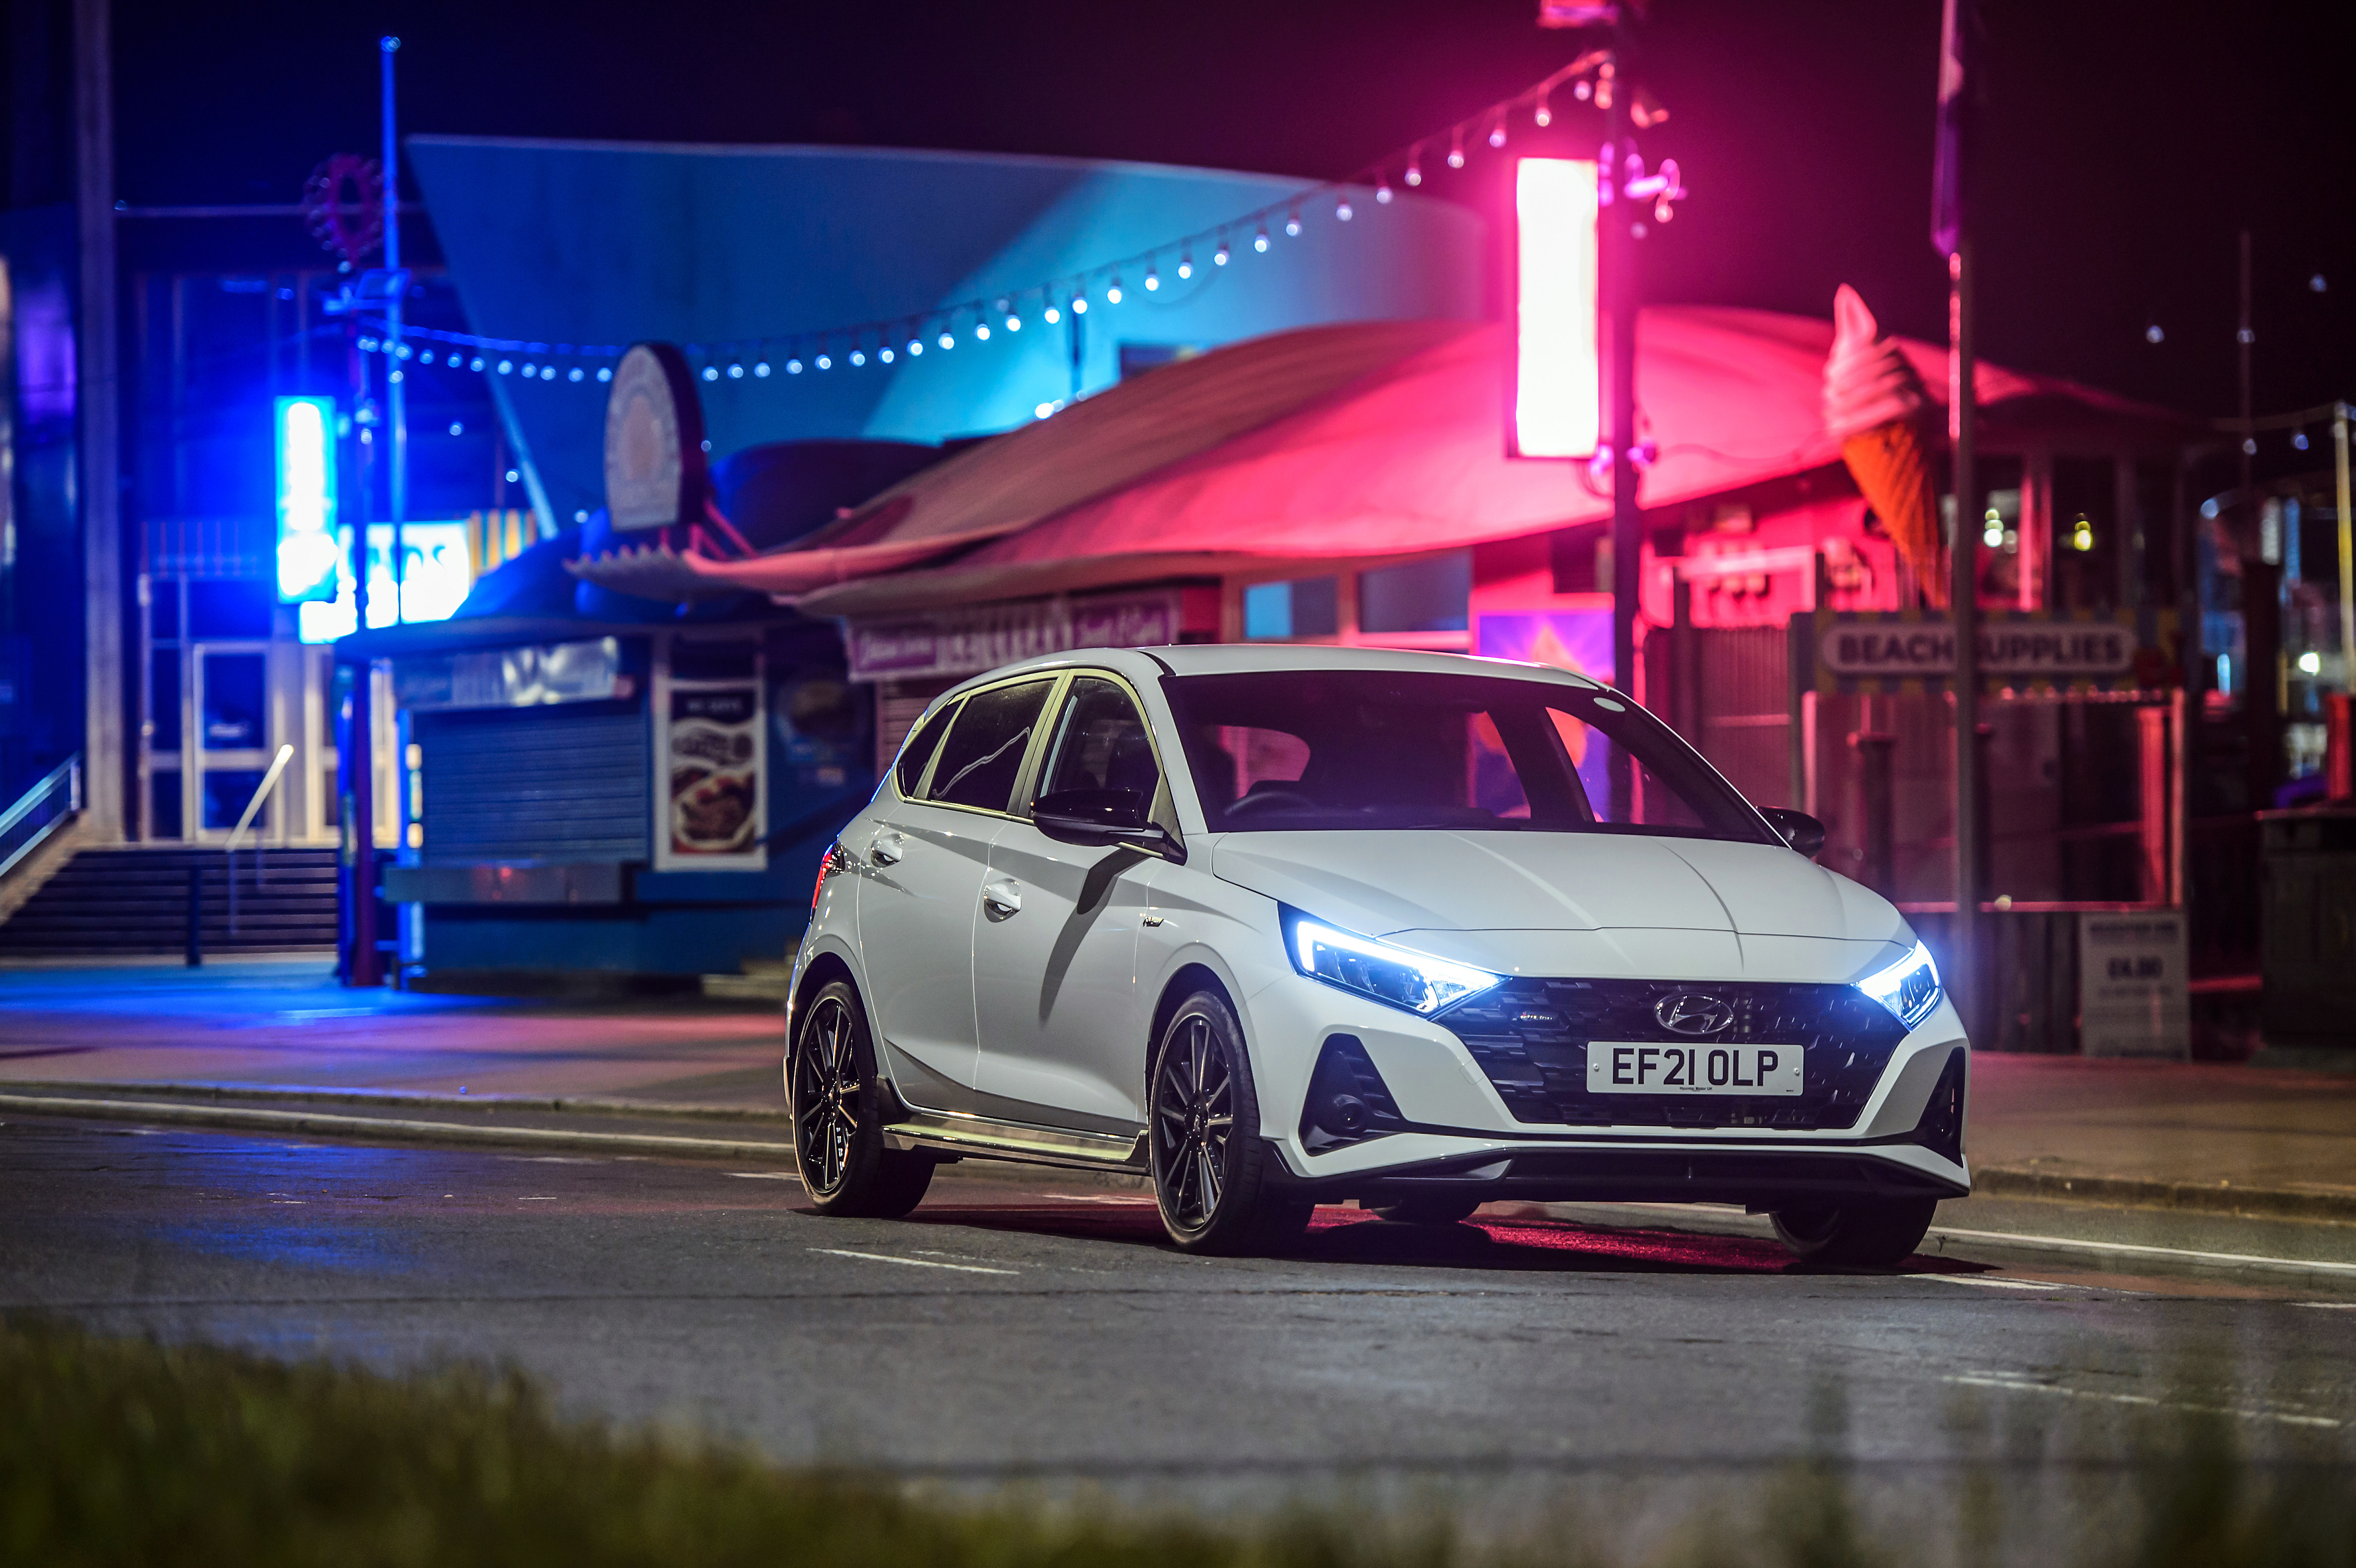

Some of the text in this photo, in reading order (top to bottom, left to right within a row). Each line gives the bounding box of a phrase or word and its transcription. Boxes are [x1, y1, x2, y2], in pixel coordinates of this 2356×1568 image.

[1838, 634, 1953, 663] BEACH
[1613, 1048, 1779, 1086] EF21 OLP
